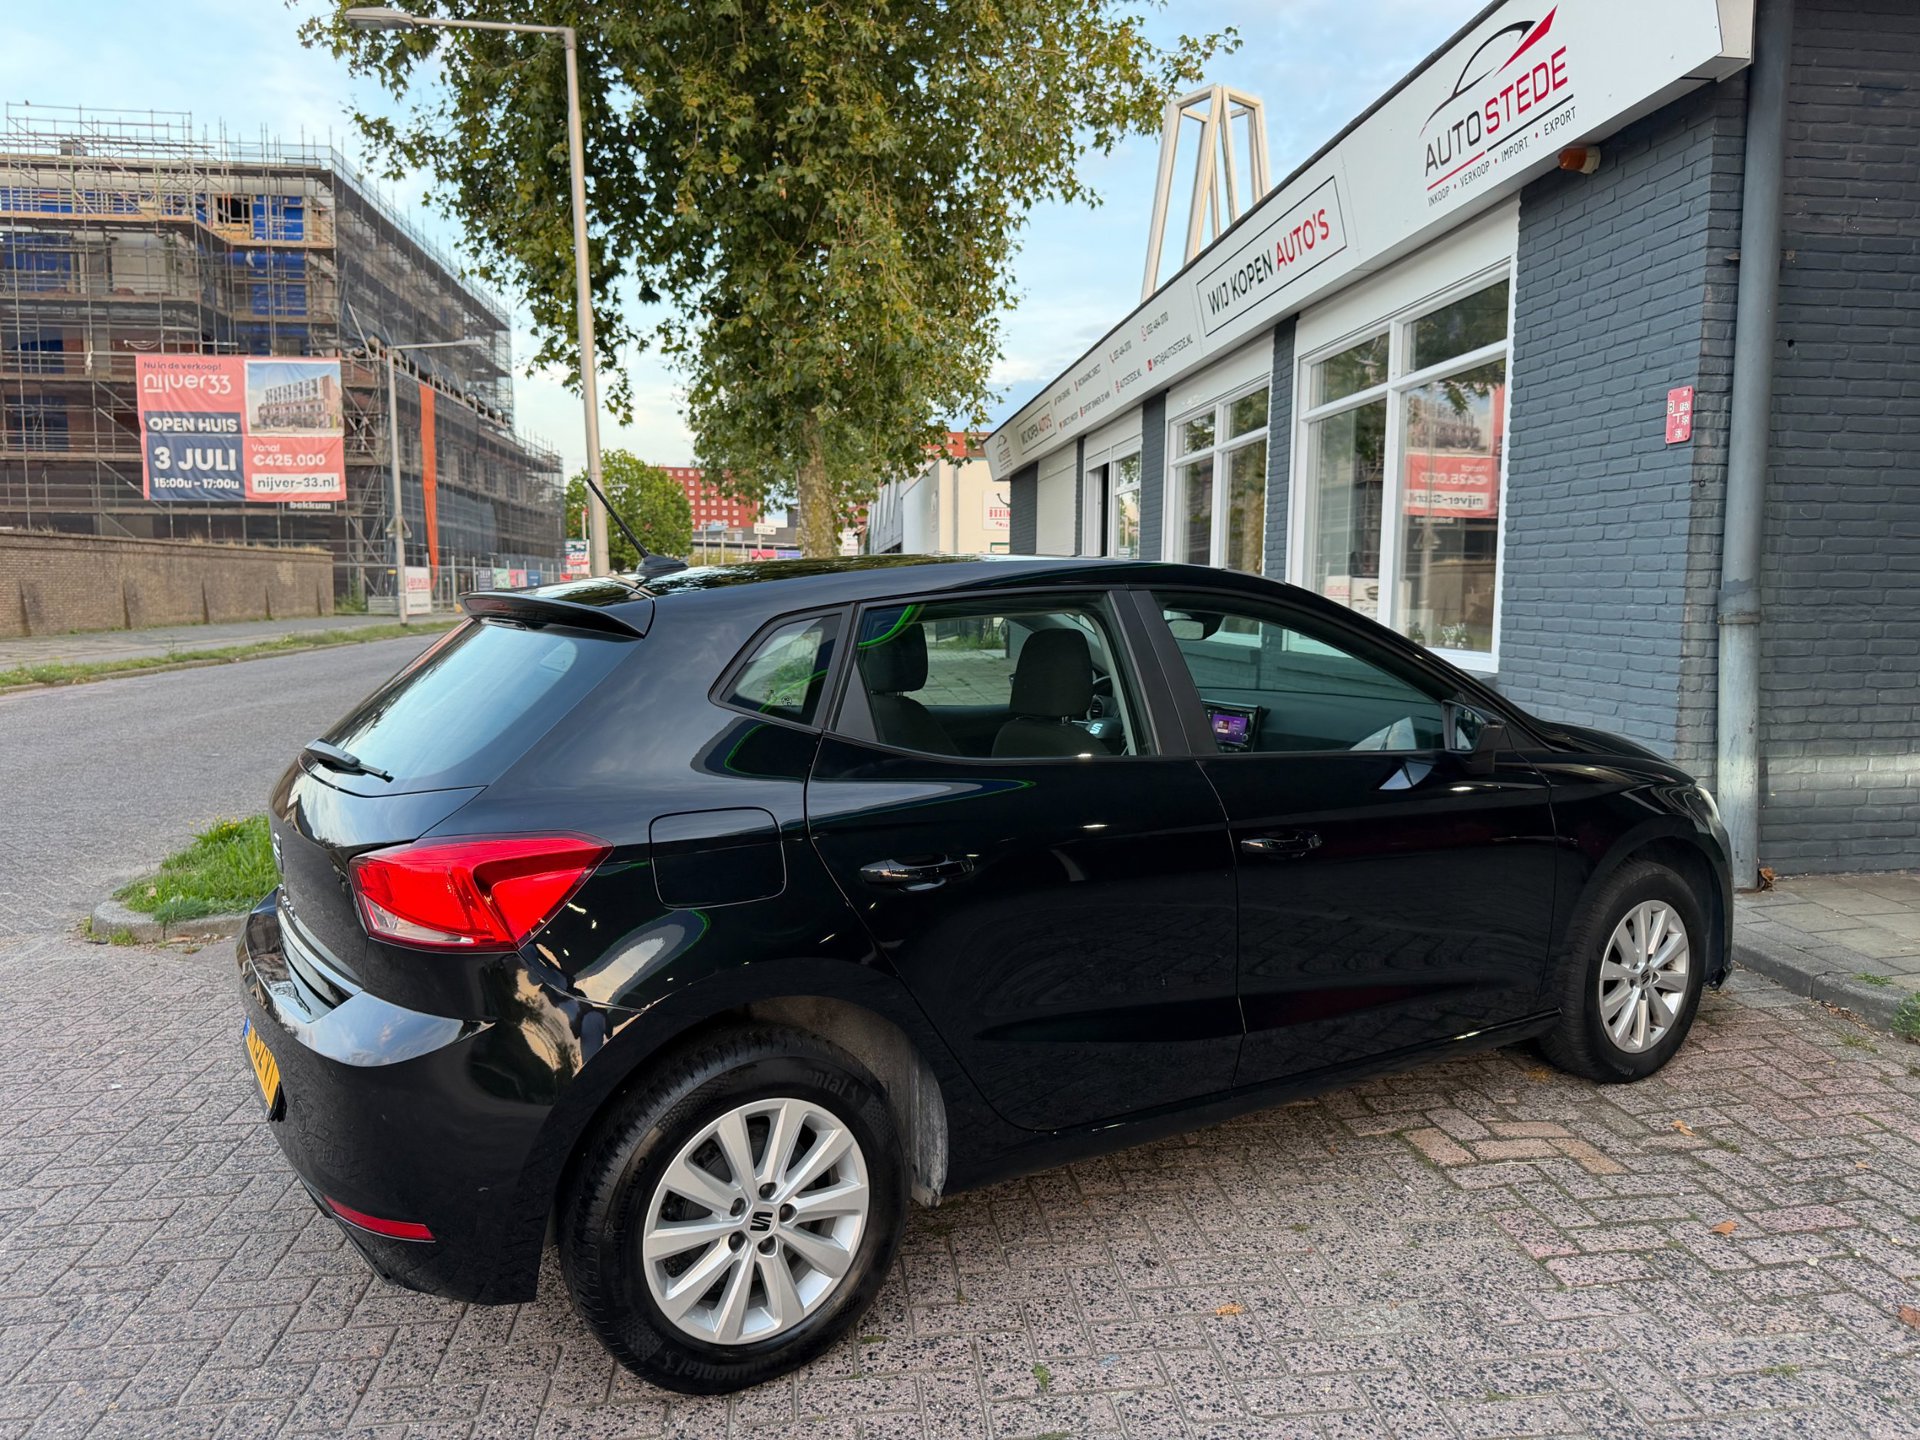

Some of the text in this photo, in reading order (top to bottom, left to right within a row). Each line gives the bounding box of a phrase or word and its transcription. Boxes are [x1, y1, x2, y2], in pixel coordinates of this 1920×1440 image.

[1425, 45, 1568, 177] AUTOSTEDE
[1427, 106, 1576, 207] INKOOP VERKOOP IMPORT EXPORT
[1207, 208, 1330, 315] WIJ KOPEN AUTO'S
[168, 361, 180, 369] de
[182, 362, 222, 371] verkoop!
[148, 416, 239, 433] OPEN HUIS
[153, 446, 237, 471] 3 JULI
[252, 453, 326, 466] €425.000
[257, 476, 335, 491] nijver-33.nl
